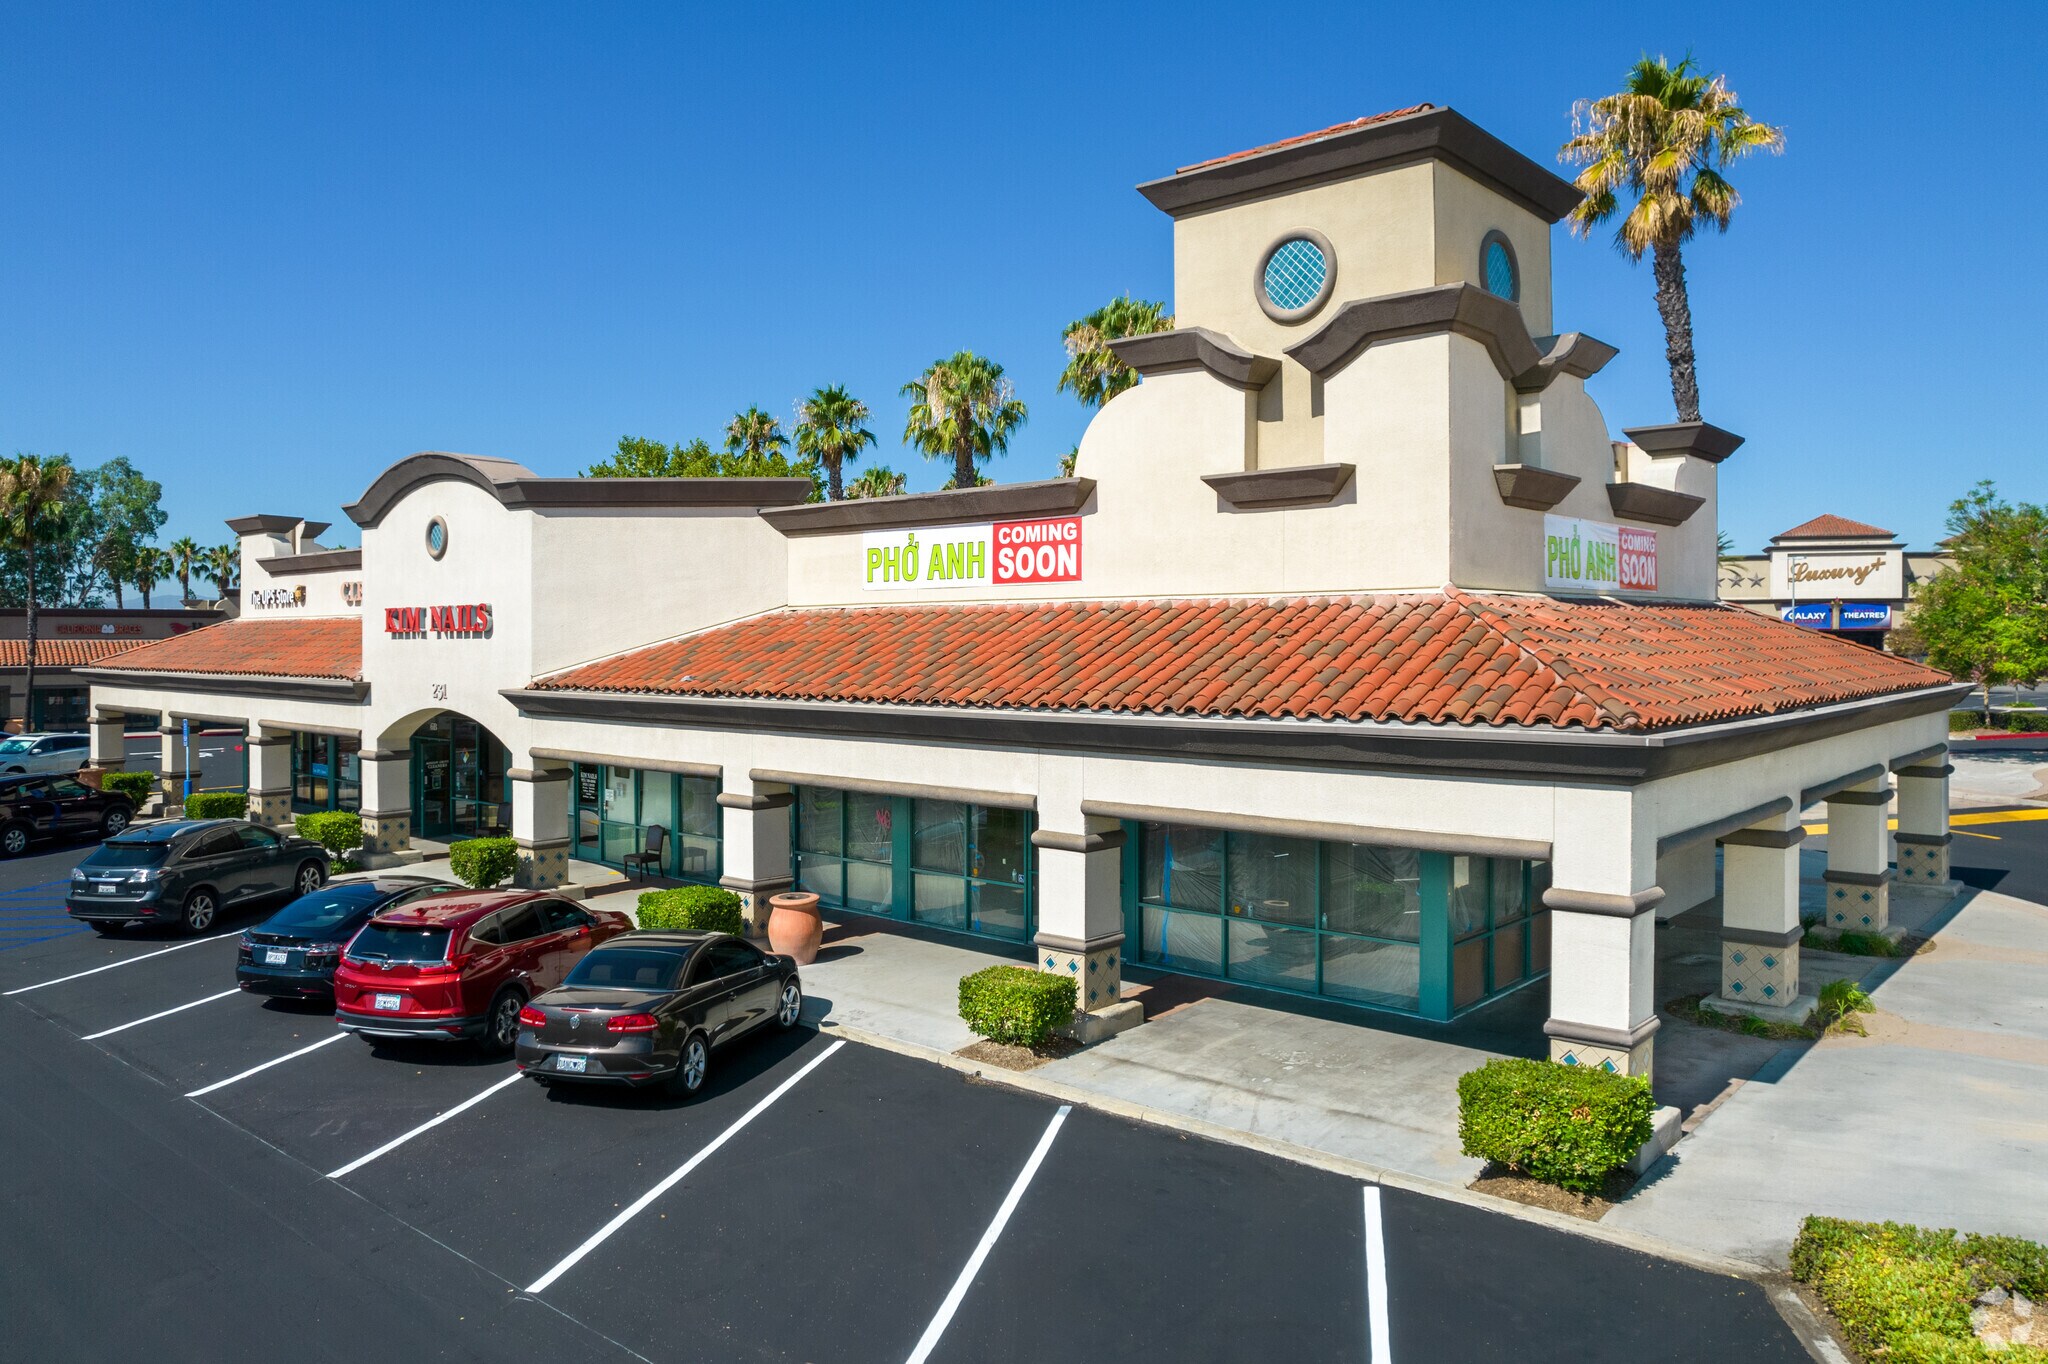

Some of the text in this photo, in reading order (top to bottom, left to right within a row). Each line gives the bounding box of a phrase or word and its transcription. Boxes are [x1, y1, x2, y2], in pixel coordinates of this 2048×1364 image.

[998, 522, 1078, 545] COMING
[1621, 533, 1656, 553] COMING
[866, 533, 985, 583] PHỞ ANH
[998, 543, 1078, 580] SOON
[1586, 540, 1617, 582] ANH
[1621, 552, 1656, 586] SOON
[251, 588, 294, 605] The UPS Store
[384, 603, 488, 632] KIM NAILS
[1788, 611, 1886, 620] GALAXY THEATRES
[56, 624, 142, 634] CALIFORNIA BRACES
[432, 683, 448, 701] 231
